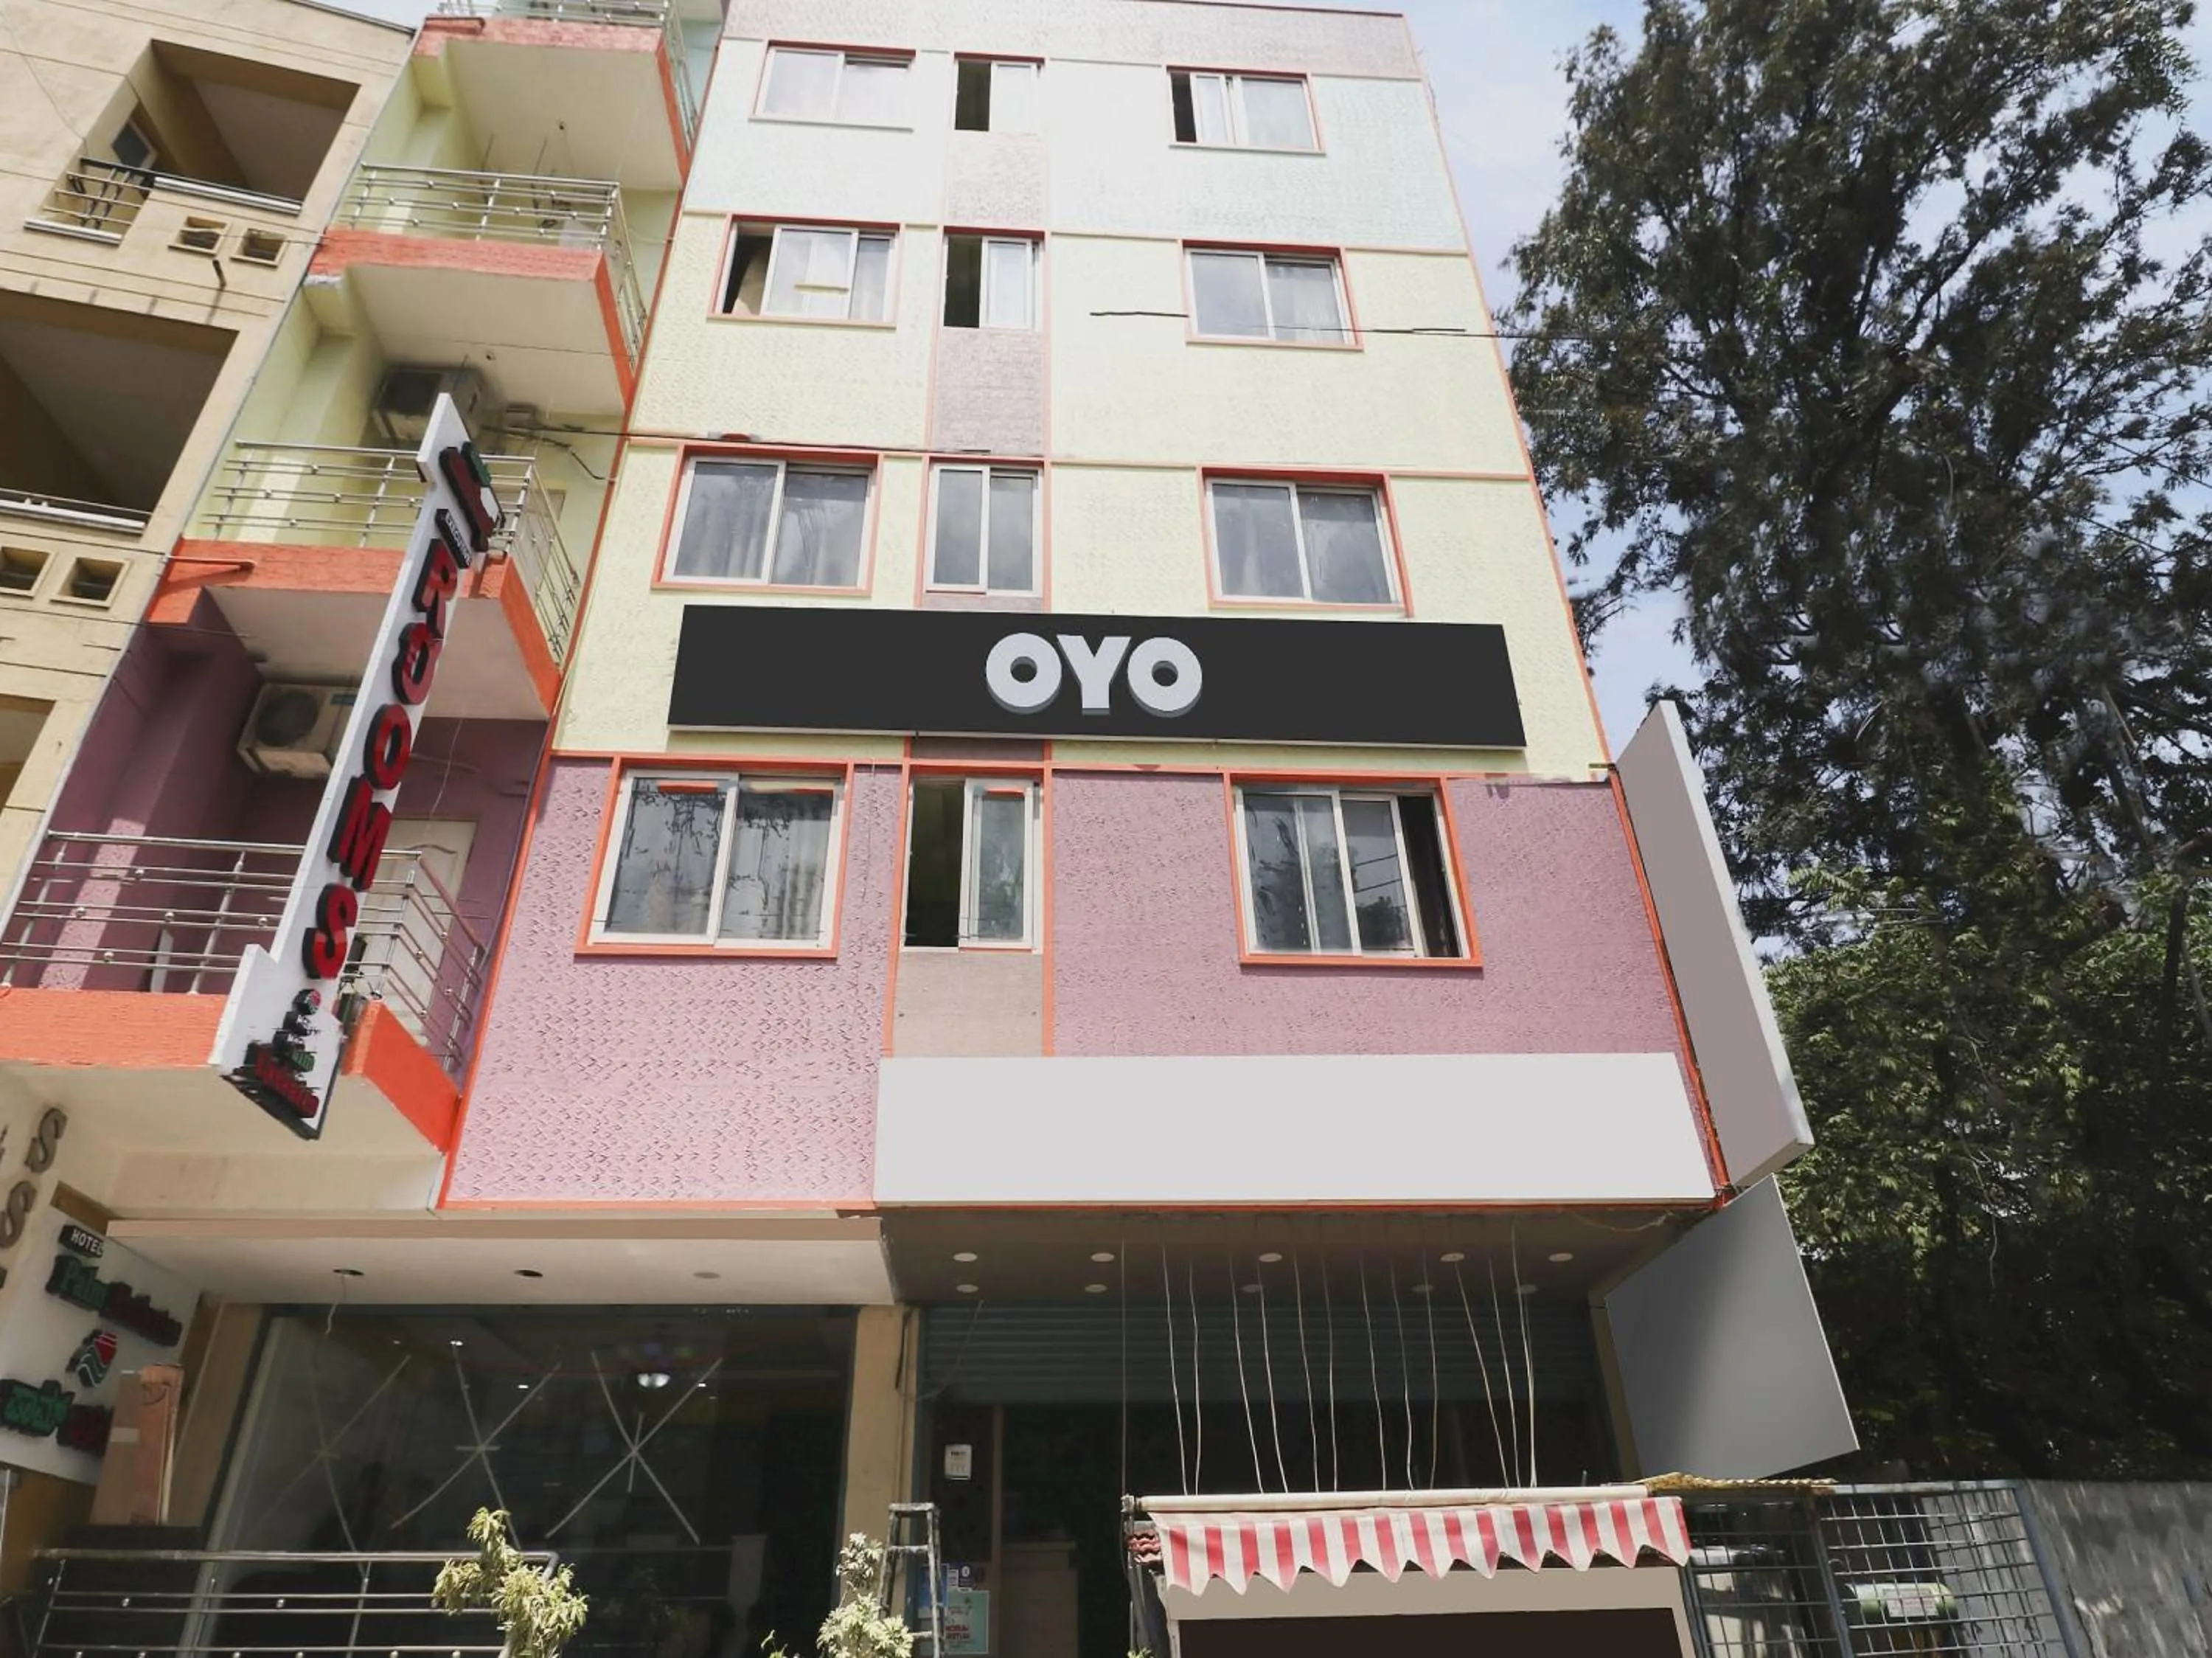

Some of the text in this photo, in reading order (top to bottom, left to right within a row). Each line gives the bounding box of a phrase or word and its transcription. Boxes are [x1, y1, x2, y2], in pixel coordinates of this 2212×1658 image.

[986, 632, 1203, 718] OYO
[302, 538, 458, 979] ROOMS
[71, 1227, 104, 1256] HOTEL
